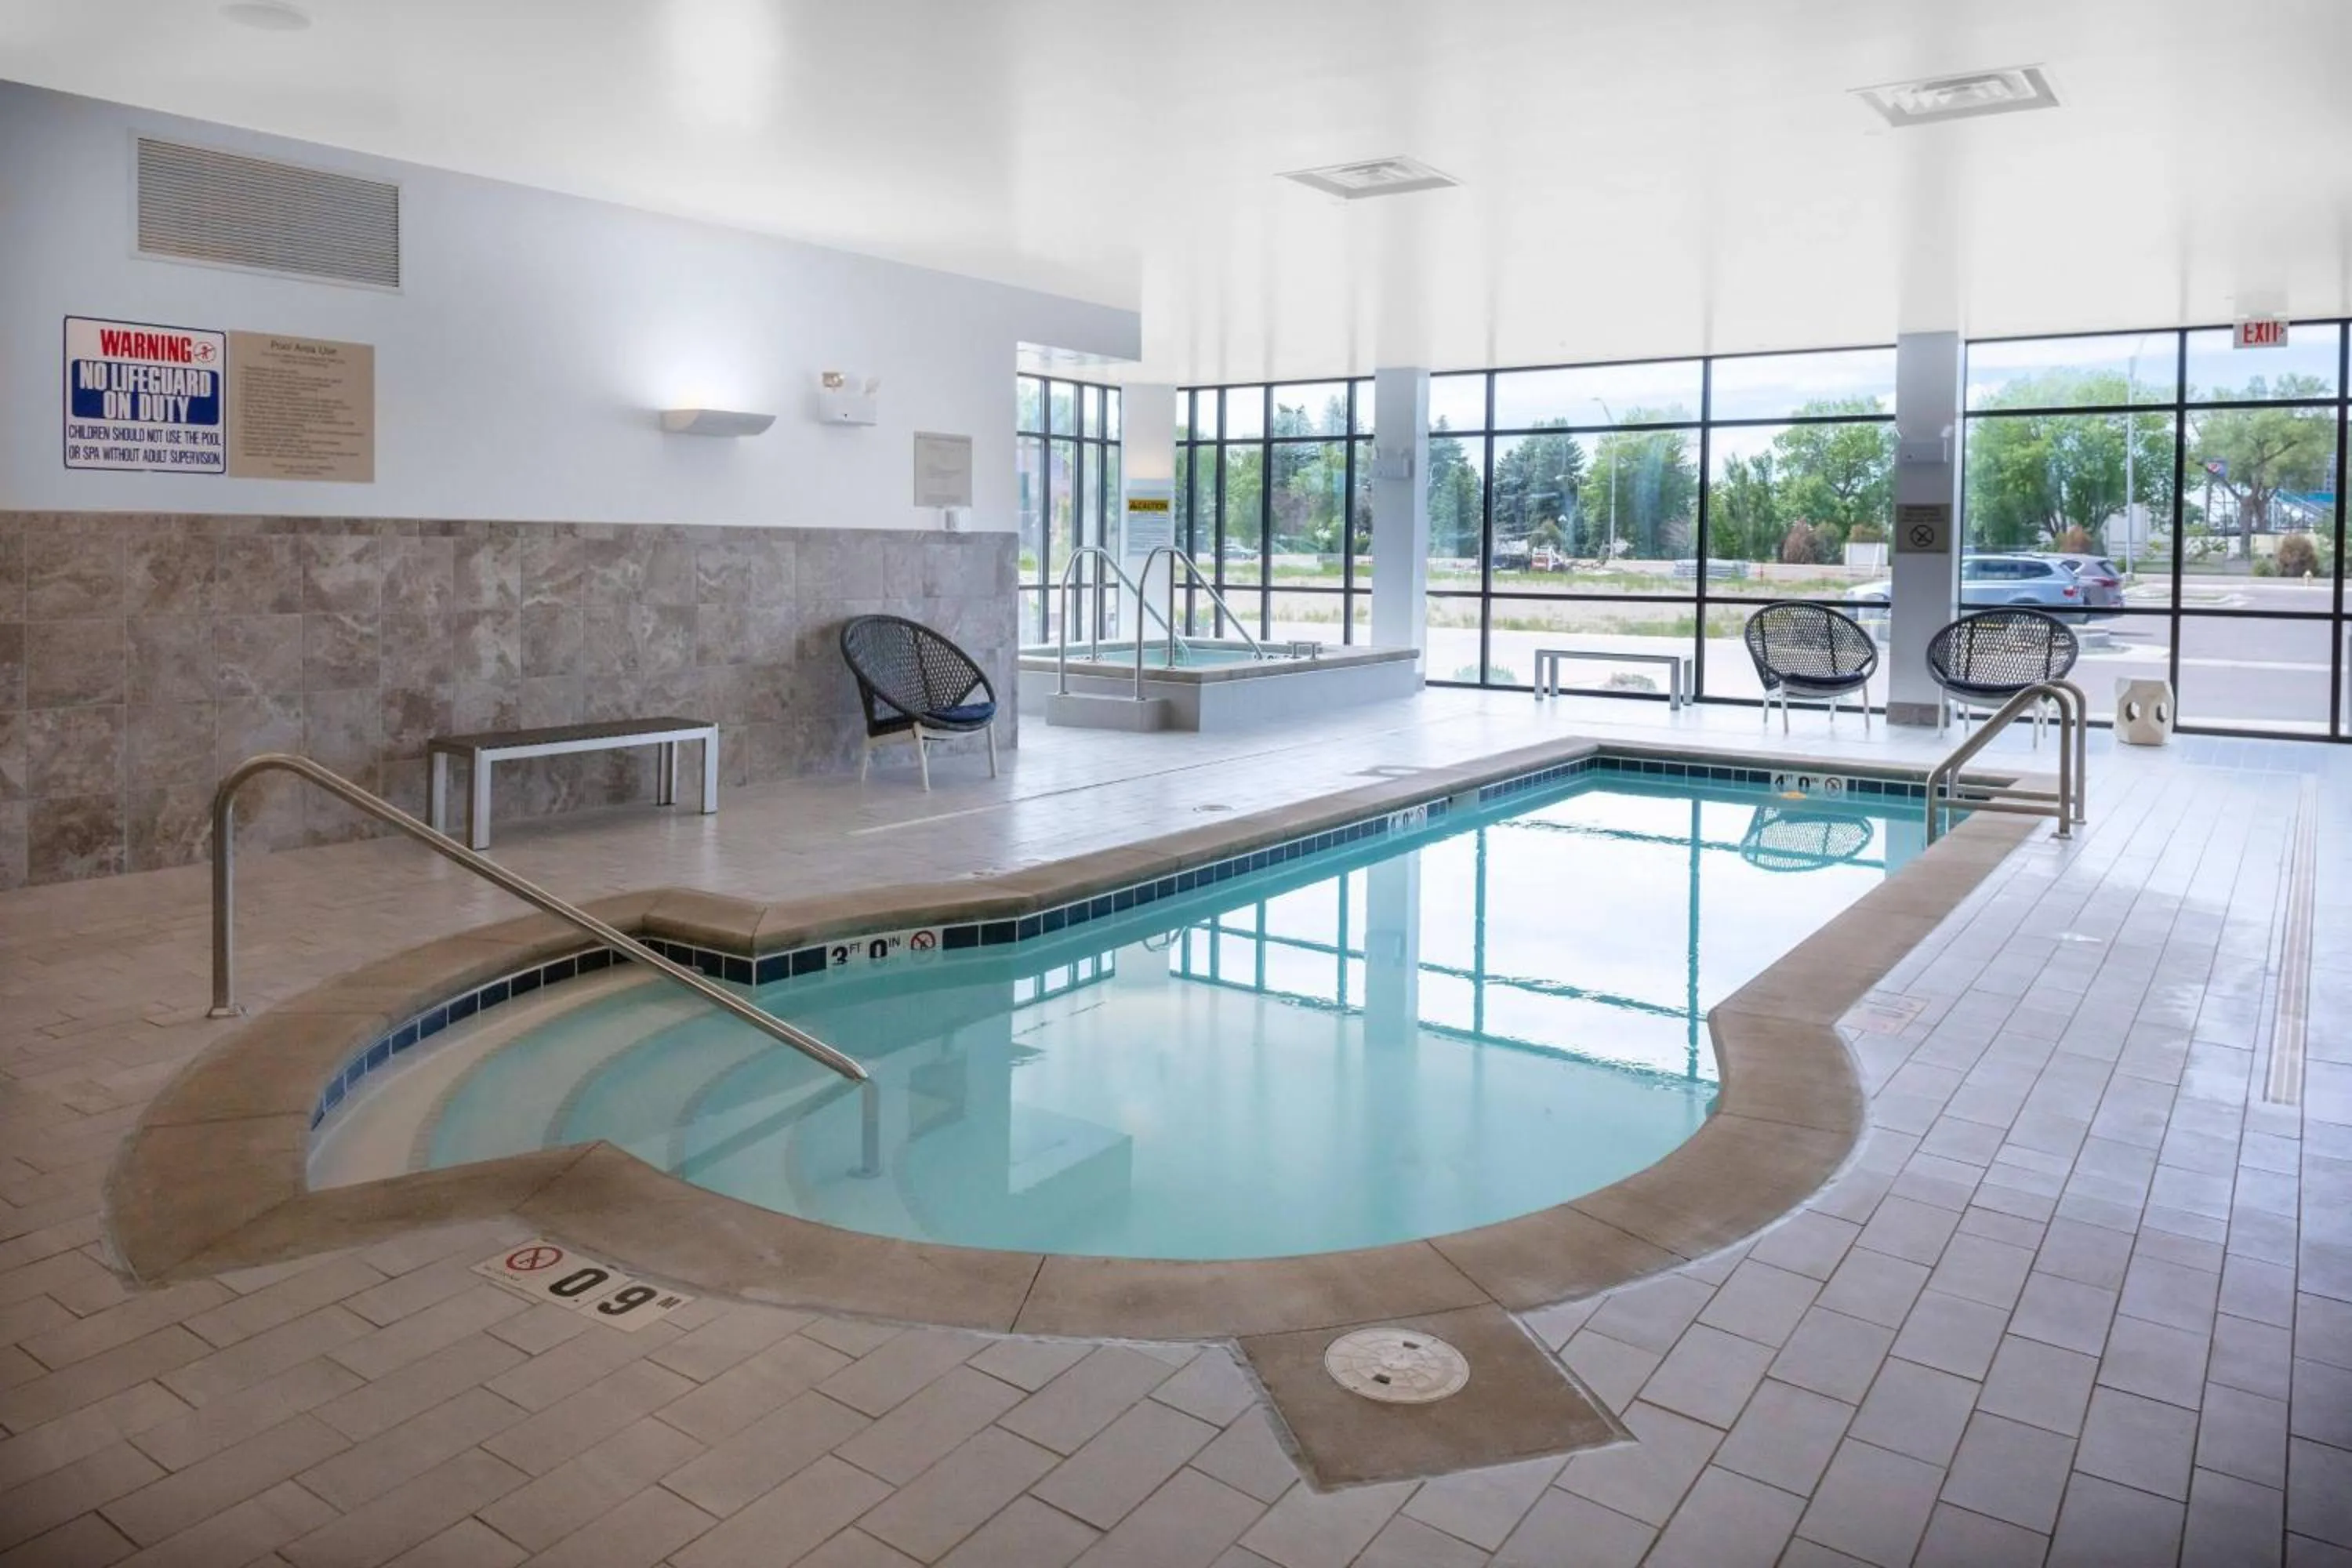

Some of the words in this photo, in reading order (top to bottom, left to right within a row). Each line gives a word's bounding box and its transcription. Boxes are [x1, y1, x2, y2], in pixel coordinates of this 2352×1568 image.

[100, 328, 192, 363] WARNING
[2244, 321, 2279, 343] EXIT
[79, 361, 107, 390] NO
[111, 363, 212, 397] LIFEGUARD
[103, 392, 132, 419] ON
[138, 394, 191, 423] DUTY
[68, 425, 110, 440] CHILDREN
[112, 427, 145, 441] SHOULD
[147, 429, 163, 443] NOT
[165, 430, 182, 444] USE
[184, 430, 198, 445] THE
[201, 432, 220, 446] POOL
[68, 447, 81, 459] OR
[82, 447, 100, 460] SPA
[103, 448, 140, 462] WITHOUT
[143, 449, 167, 463] ADULT
[831, 946, 848, 965] 3
[849, 942, 862, 954] FT
[869, 939, 887, 959] 0
[888, 935, 901, 948] IN
